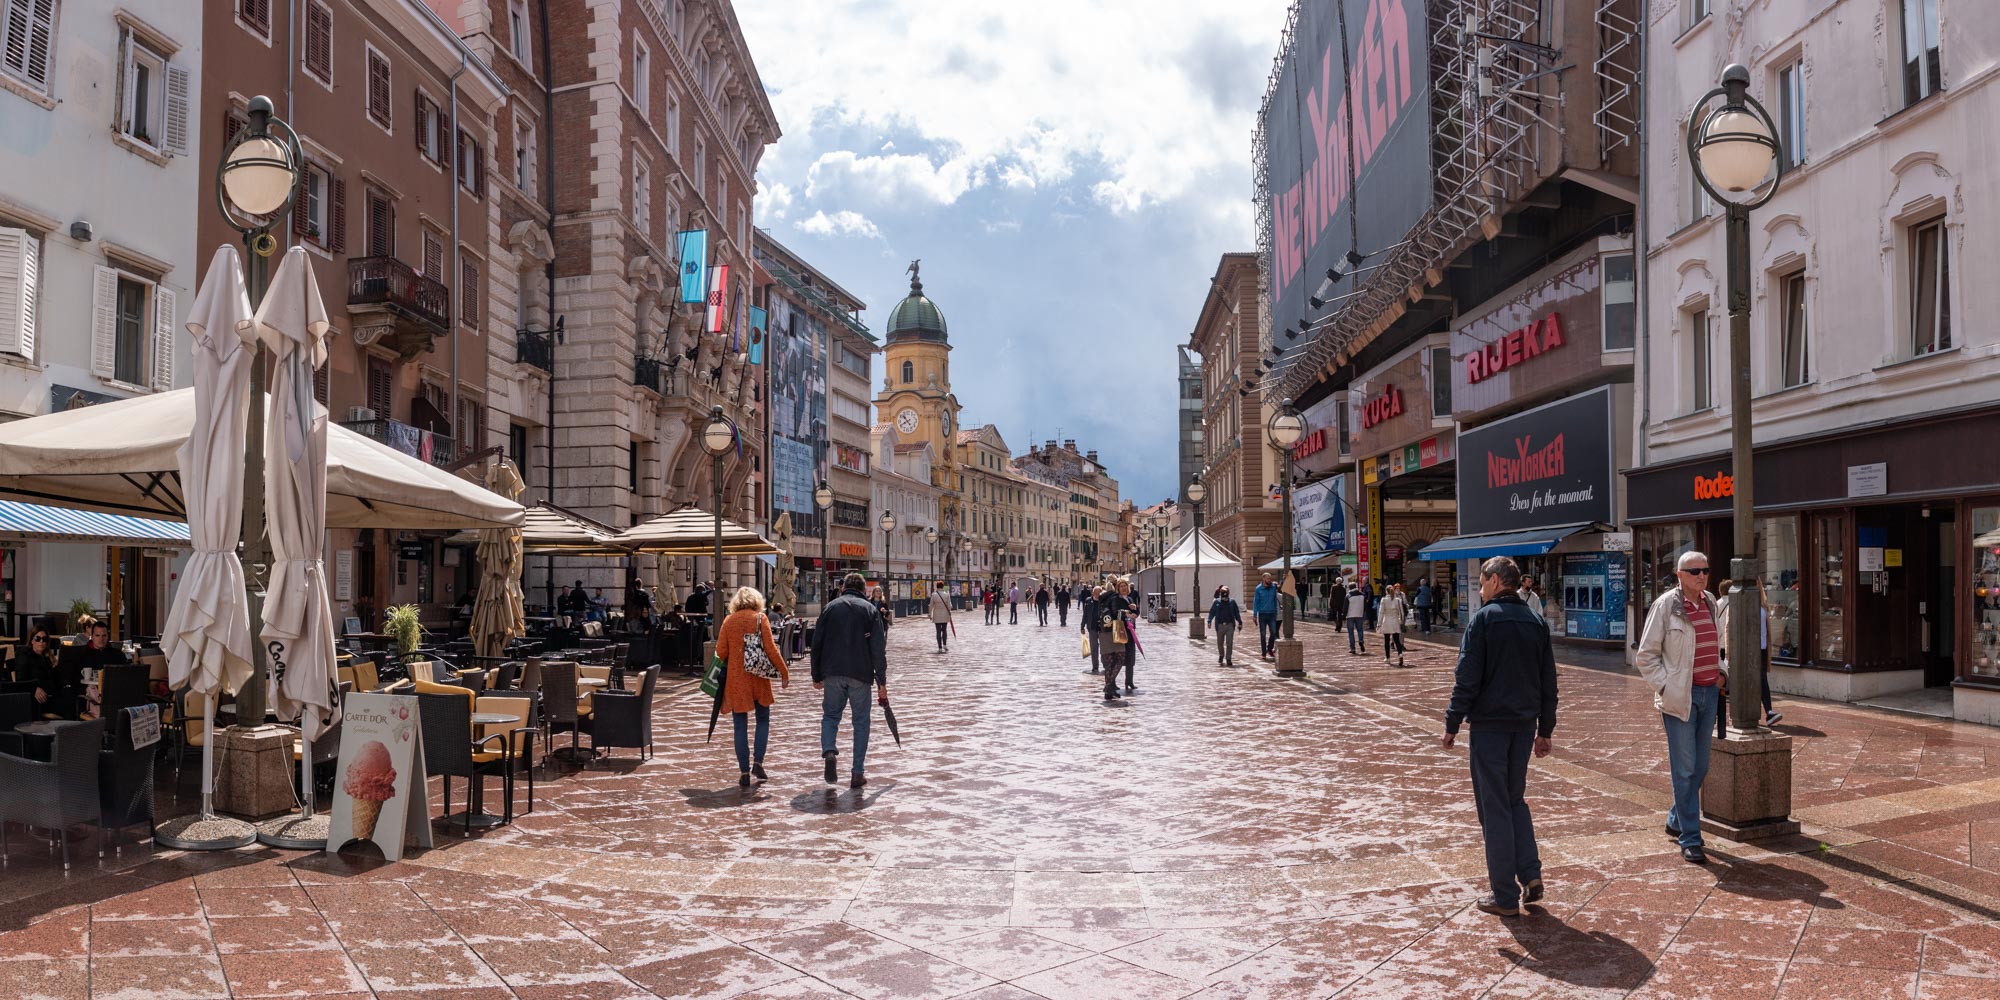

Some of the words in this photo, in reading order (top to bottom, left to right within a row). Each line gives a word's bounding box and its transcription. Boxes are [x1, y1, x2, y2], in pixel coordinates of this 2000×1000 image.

[1467, 311, 1566, 385] RIJEKA
[1362, 384, 1404, 429] KUĆA
[1509, 492, 1531, 512] Dress
[1528, 489, 1543, 514] for
[1544, 488, 1557, 507] the
[1557, 484, 1594, 505] moment.
[840, 543, 867, 557] KORZO
[345, 712, 368, 722] CARTE
[369, 714, 389, 726] D'OR
